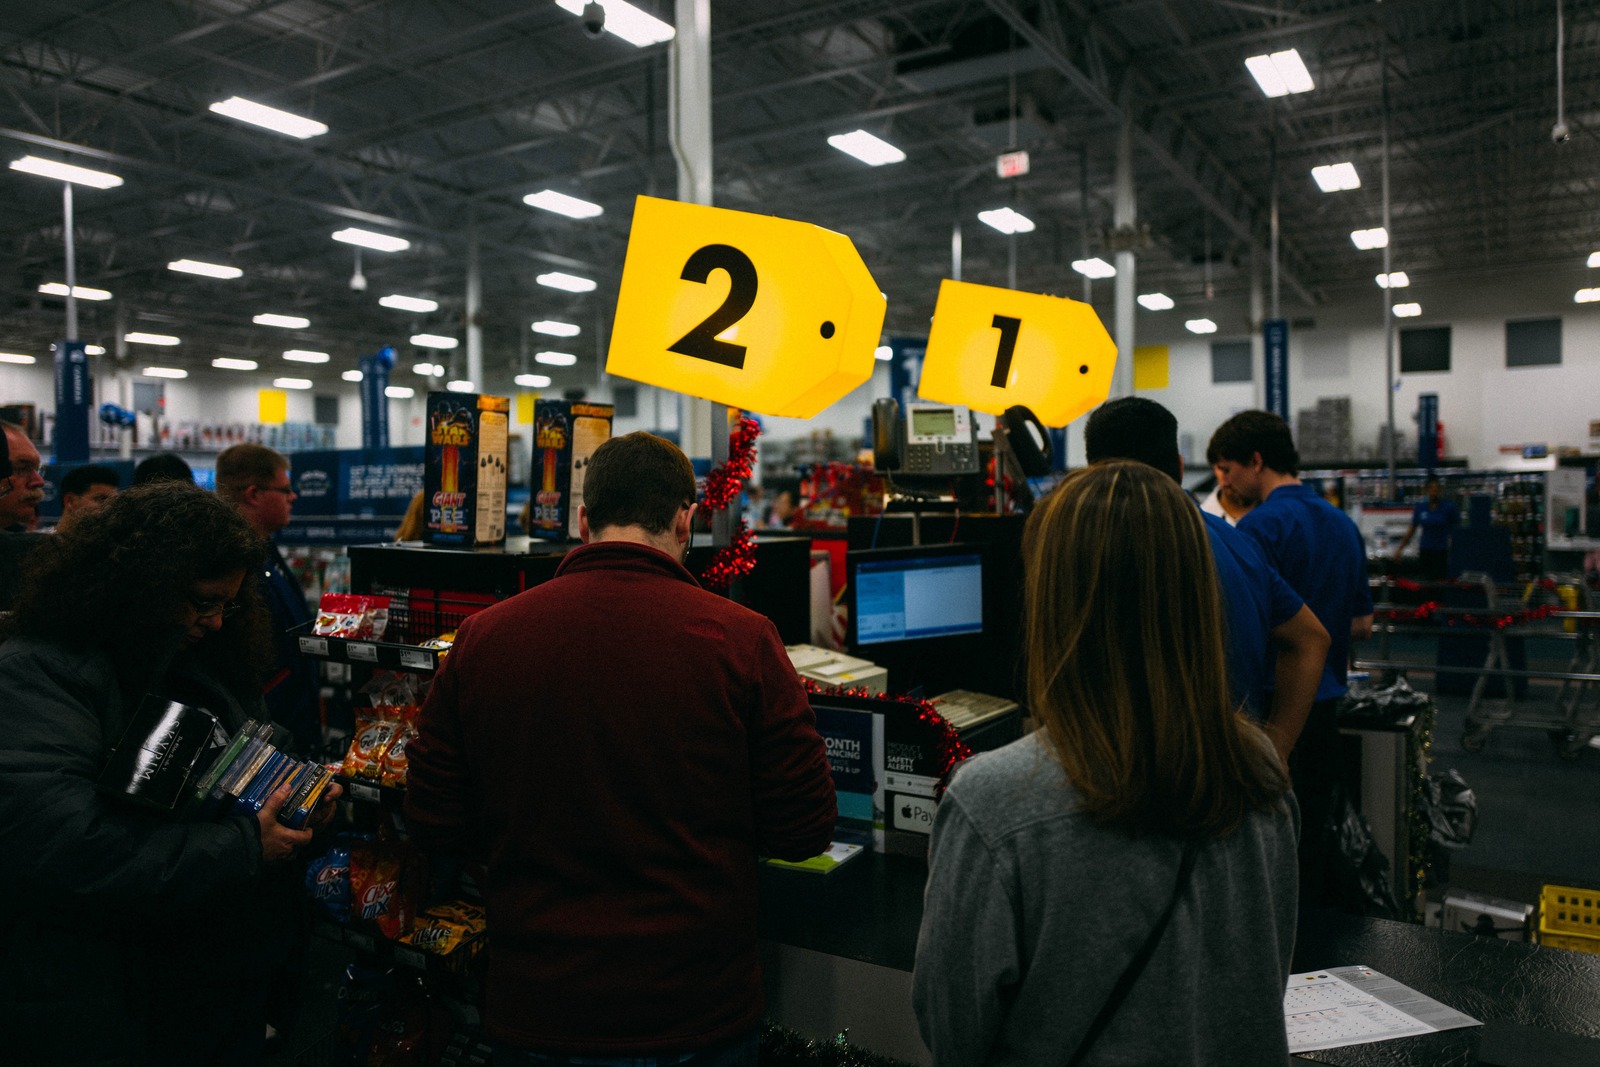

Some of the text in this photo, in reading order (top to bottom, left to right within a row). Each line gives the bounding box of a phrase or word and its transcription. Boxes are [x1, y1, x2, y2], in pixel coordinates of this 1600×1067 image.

[666, 243, 759, 370] 2
[989, 314, 1021, 388] 1
[431, 433, 470, 446] WARS
[432, 491, 467, 507] GIANT
[536, 490, 562, 505] GIANT
[430, 508, 465, 525] PEZ
[534, 506, 560, 522] PEZ
[139, 717, 181, 781] SKYRIM
[821, 737, 860, 751] ONTH
[887, 742, 921, 752] PRODUCT
[886, 762, 914, 772] ALERTS
[887, 755, 915, 766] SAFETY
[914, 806, 935, 826] Pay
[361, 881, 399, 906] Chex
